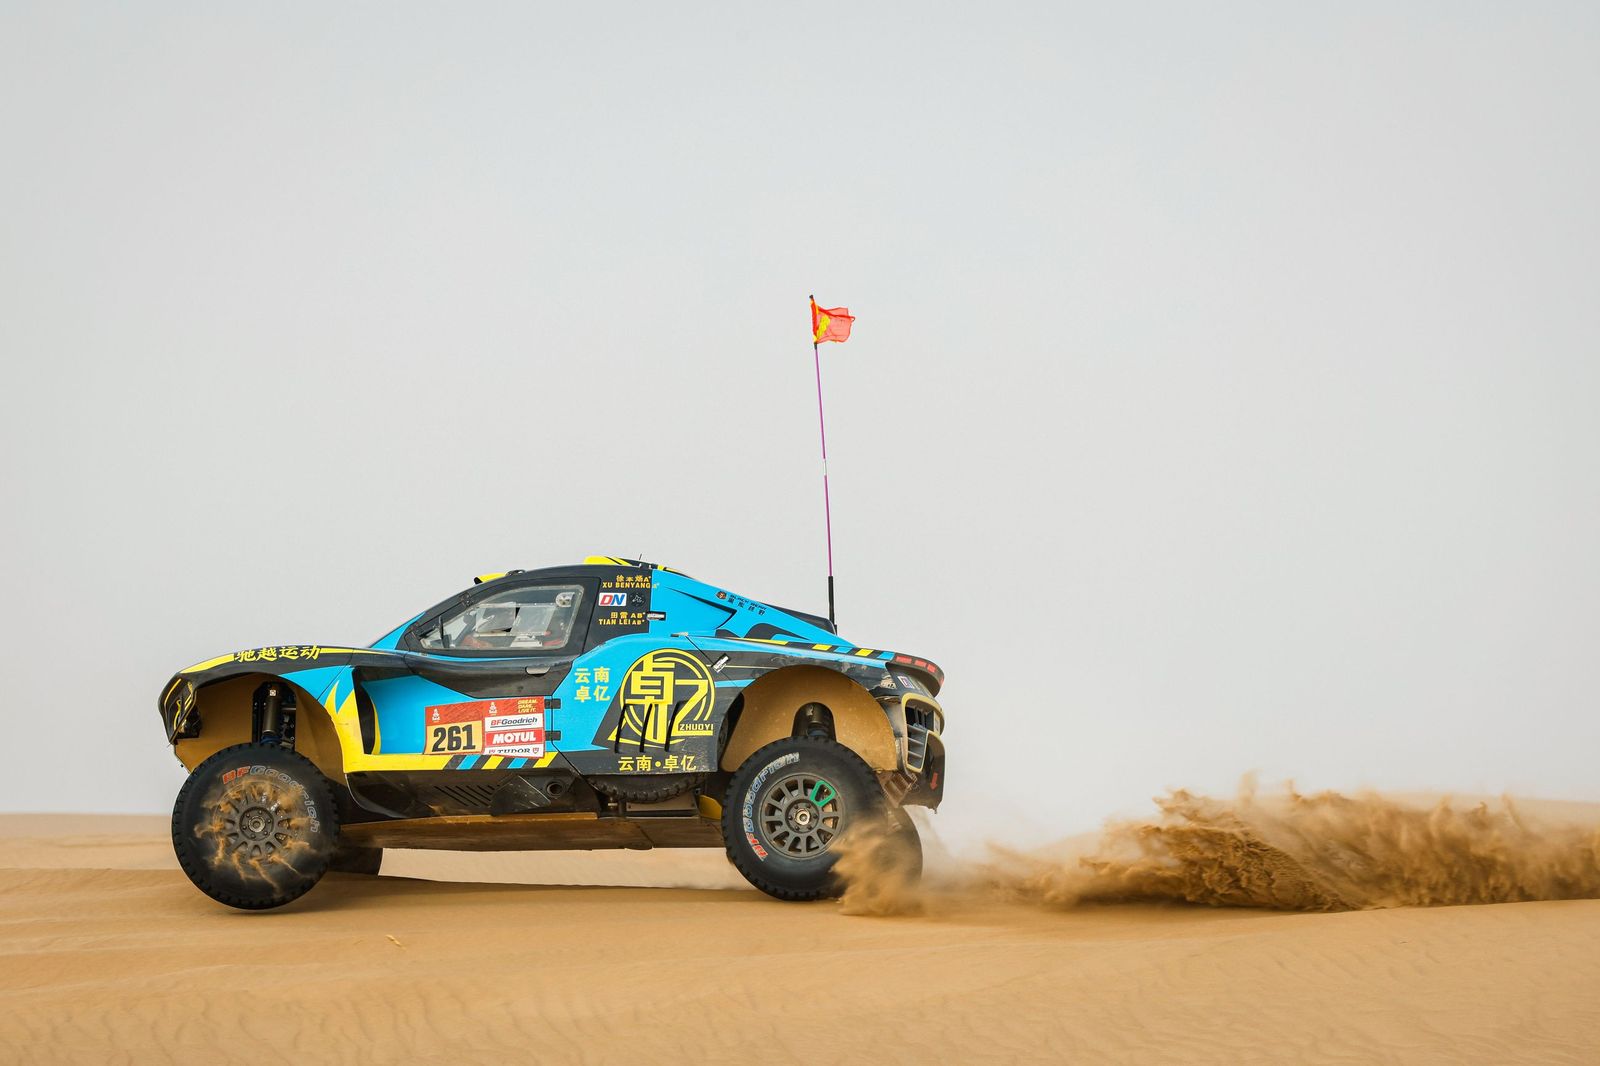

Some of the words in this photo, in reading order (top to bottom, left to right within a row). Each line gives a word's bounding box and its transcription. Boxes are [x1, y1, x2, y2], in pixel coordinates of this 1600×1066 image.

[600, 594, 626, 606] DN
[234, 646, 320, 662] 驰越运动
[574, 666, 610, 684] 云南
[574, 685, 610, 702] 卓亿
[490, 717, 538, 726] BFGoodrich
[432, 724, 476, 752] 261
[492, 732, 536, 744] MOTUL
